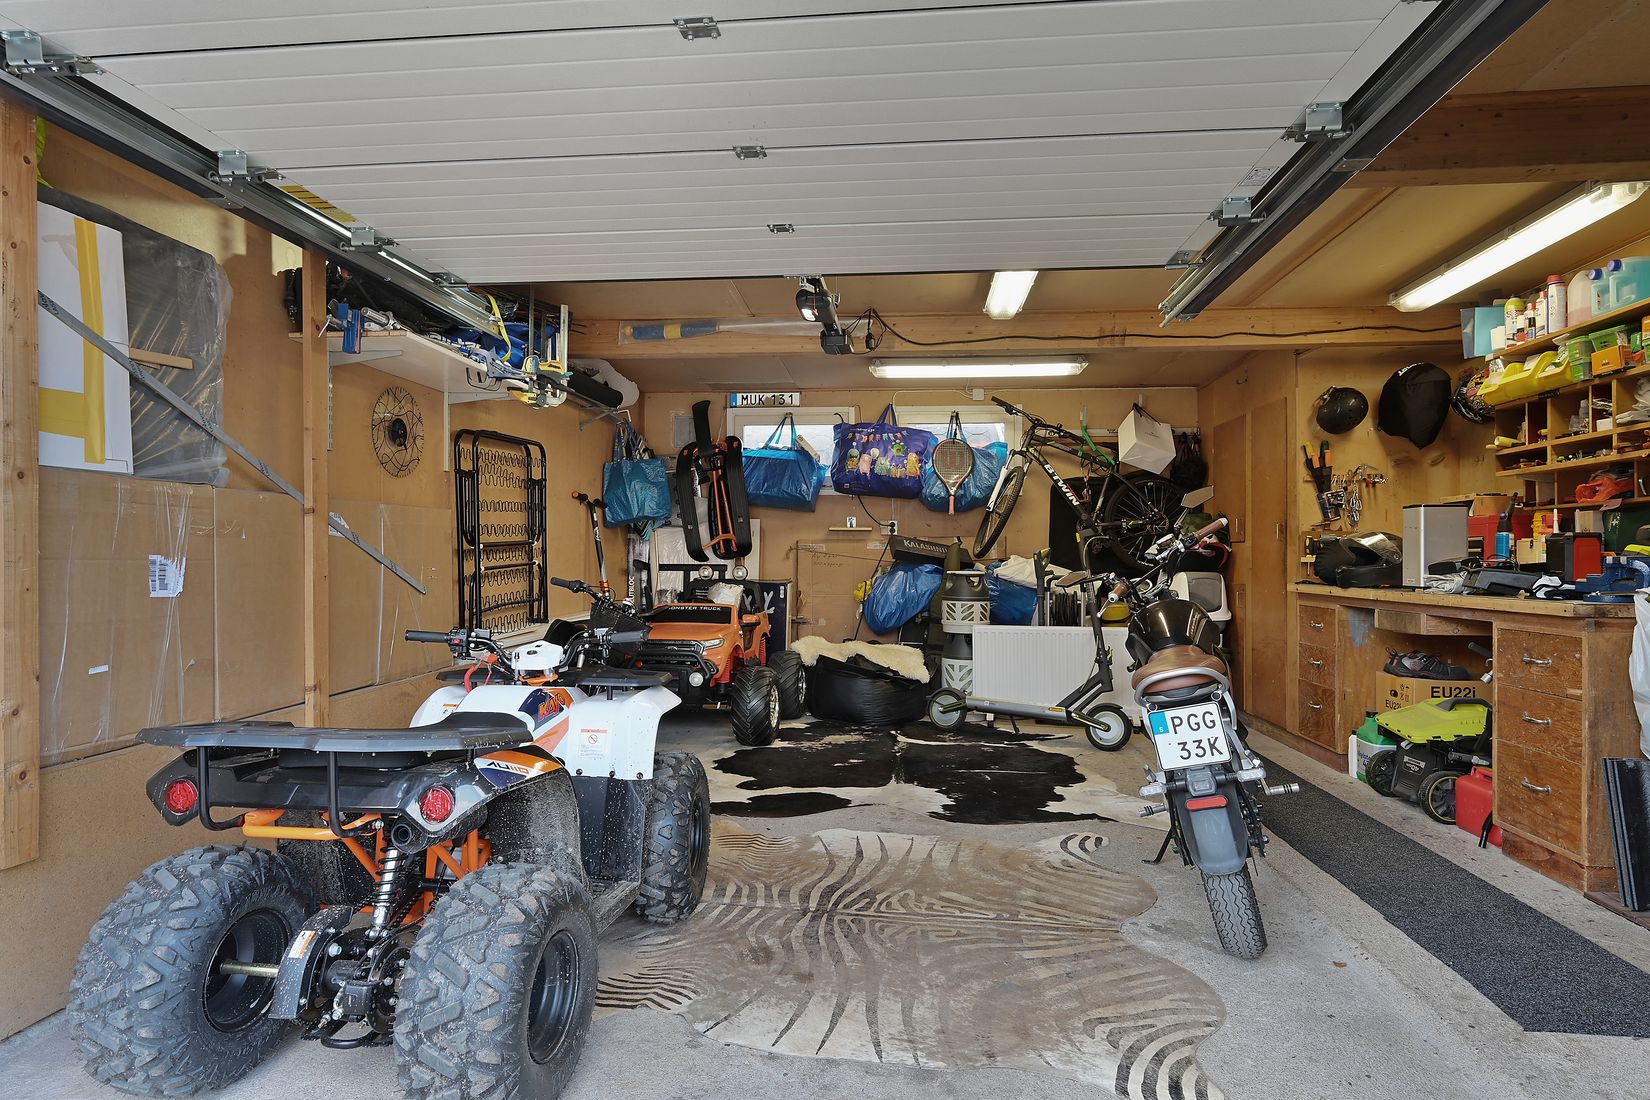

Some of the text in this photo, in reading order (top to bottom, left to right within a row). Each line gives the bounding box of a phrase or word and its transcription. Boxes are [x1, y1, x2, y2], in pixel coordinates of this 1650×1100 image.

[741, 394, 794, 406] MUK 131
[1430, 686, 1476, 699] EU22i
[539, 692, 566, 721] KAYO
[1170, 710, 1217, 735] PGG
[1177, 736, 1224, 761] 33K
